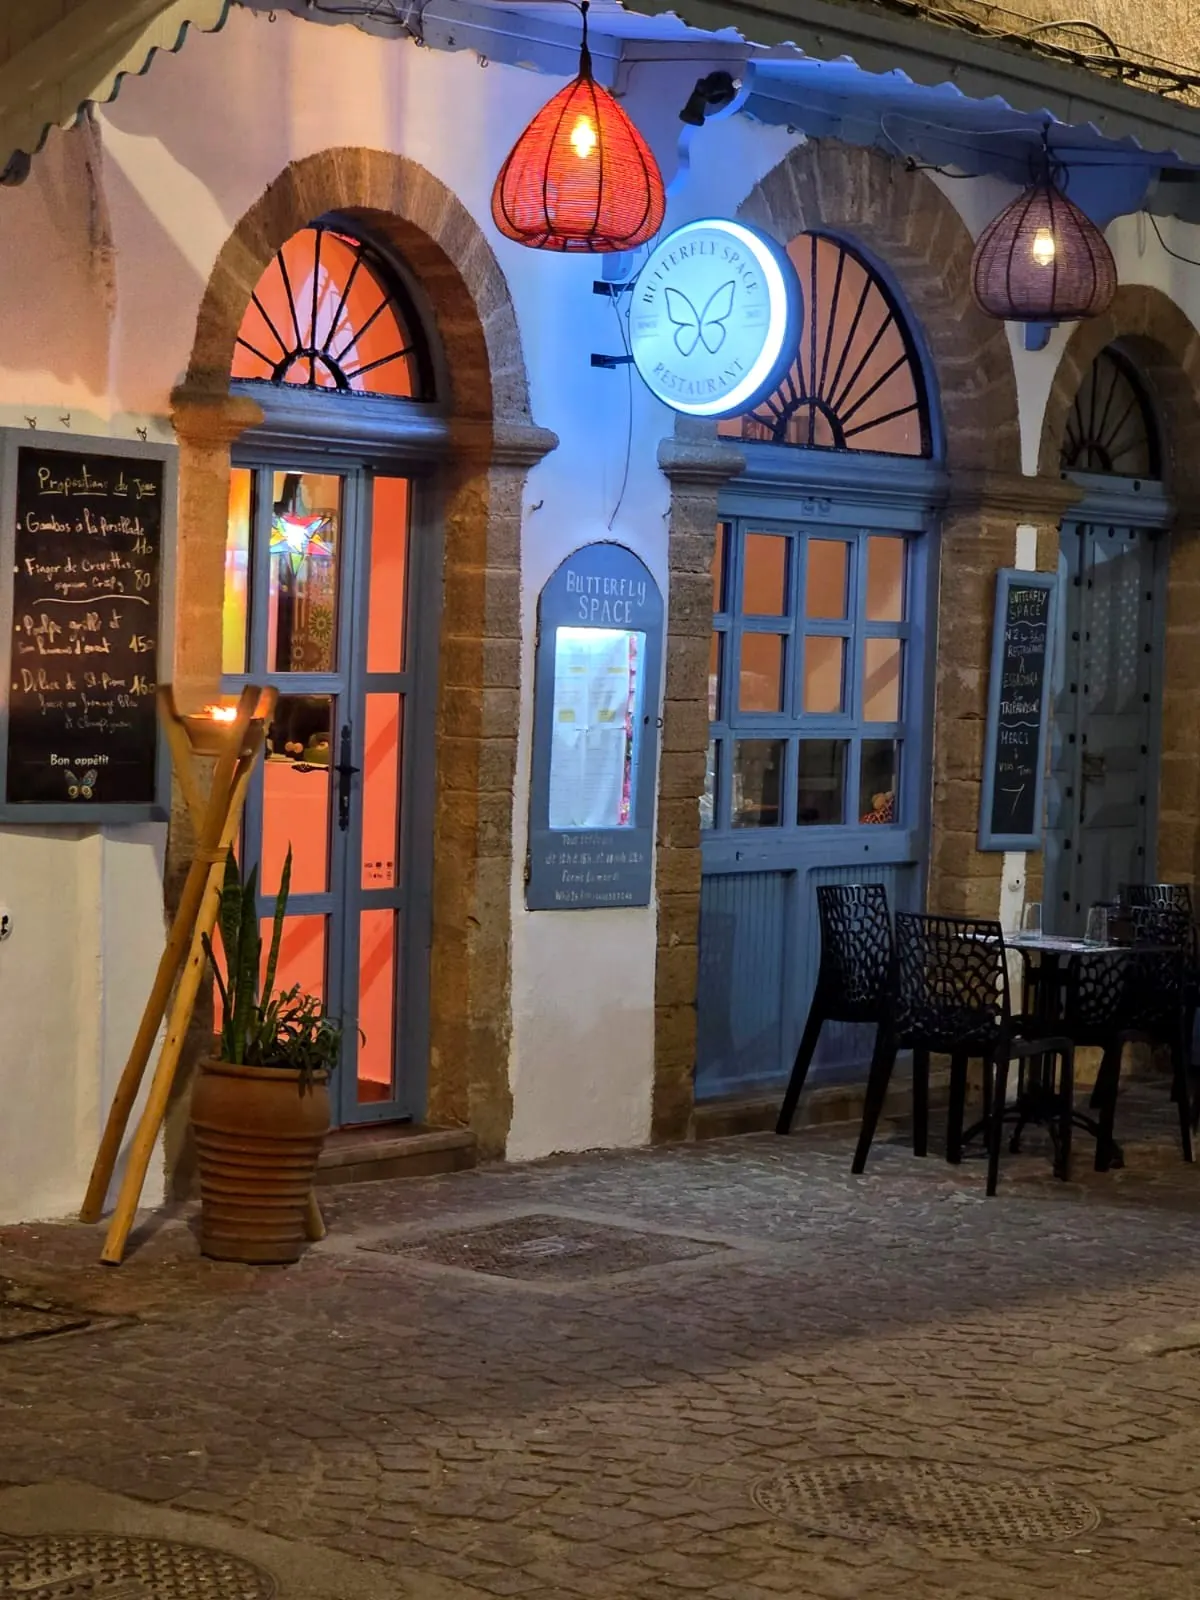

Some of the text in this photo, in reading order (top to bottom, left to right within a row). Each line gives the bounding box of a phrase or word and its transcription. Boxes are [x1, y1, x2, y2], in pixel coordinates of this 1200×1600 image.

[643, 241, 759, 303] BUTTERFLY SPACE
[653, 358, 744, 395] RESTAURANT
[24, 557, 61, 581] Finger
[64, 556, 77, 572] de
[134, 569, 150, 591] 80
[578, 595, 633, 624] SPACE
[1009, 604, 1041, 620] SPACE
[50, 753, 110, 767] Bon appétit
